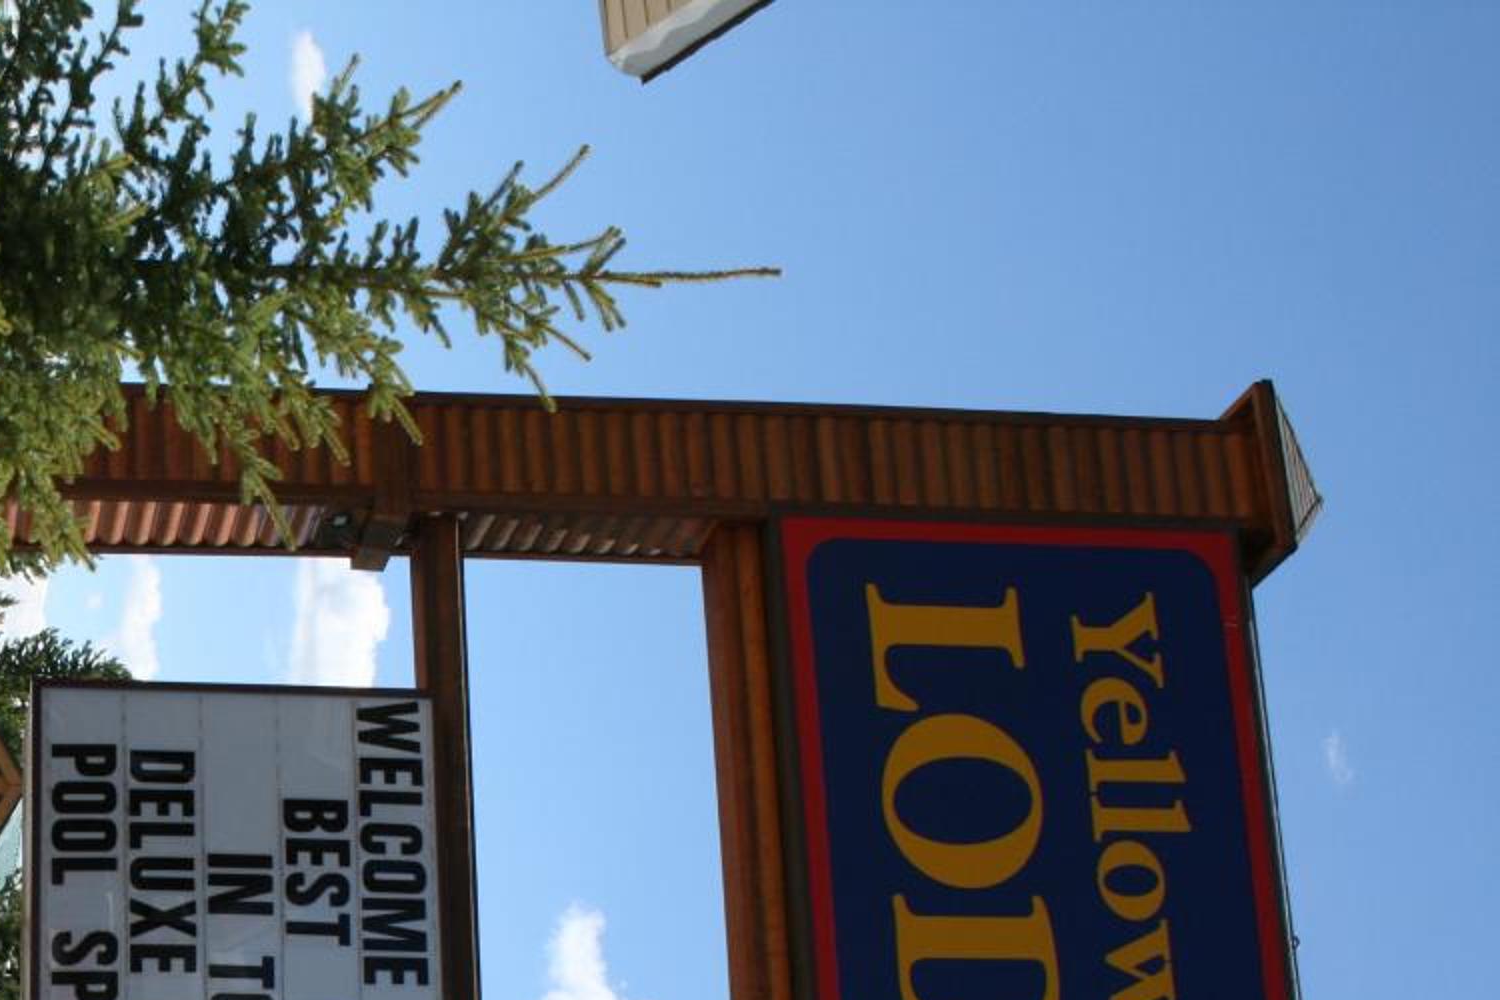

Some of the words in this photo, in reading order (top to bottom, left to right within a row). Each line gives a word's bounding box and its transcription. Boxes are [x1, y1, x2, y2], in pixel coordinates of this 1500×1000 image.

[50, 743, 119, 886] POOL
[128, 749, 198, 974] DELUXE
[207, 853, 274, 916] IN
[282, 798, 351, 947] BEST
[356, 702, 430, 986] WELCOME
